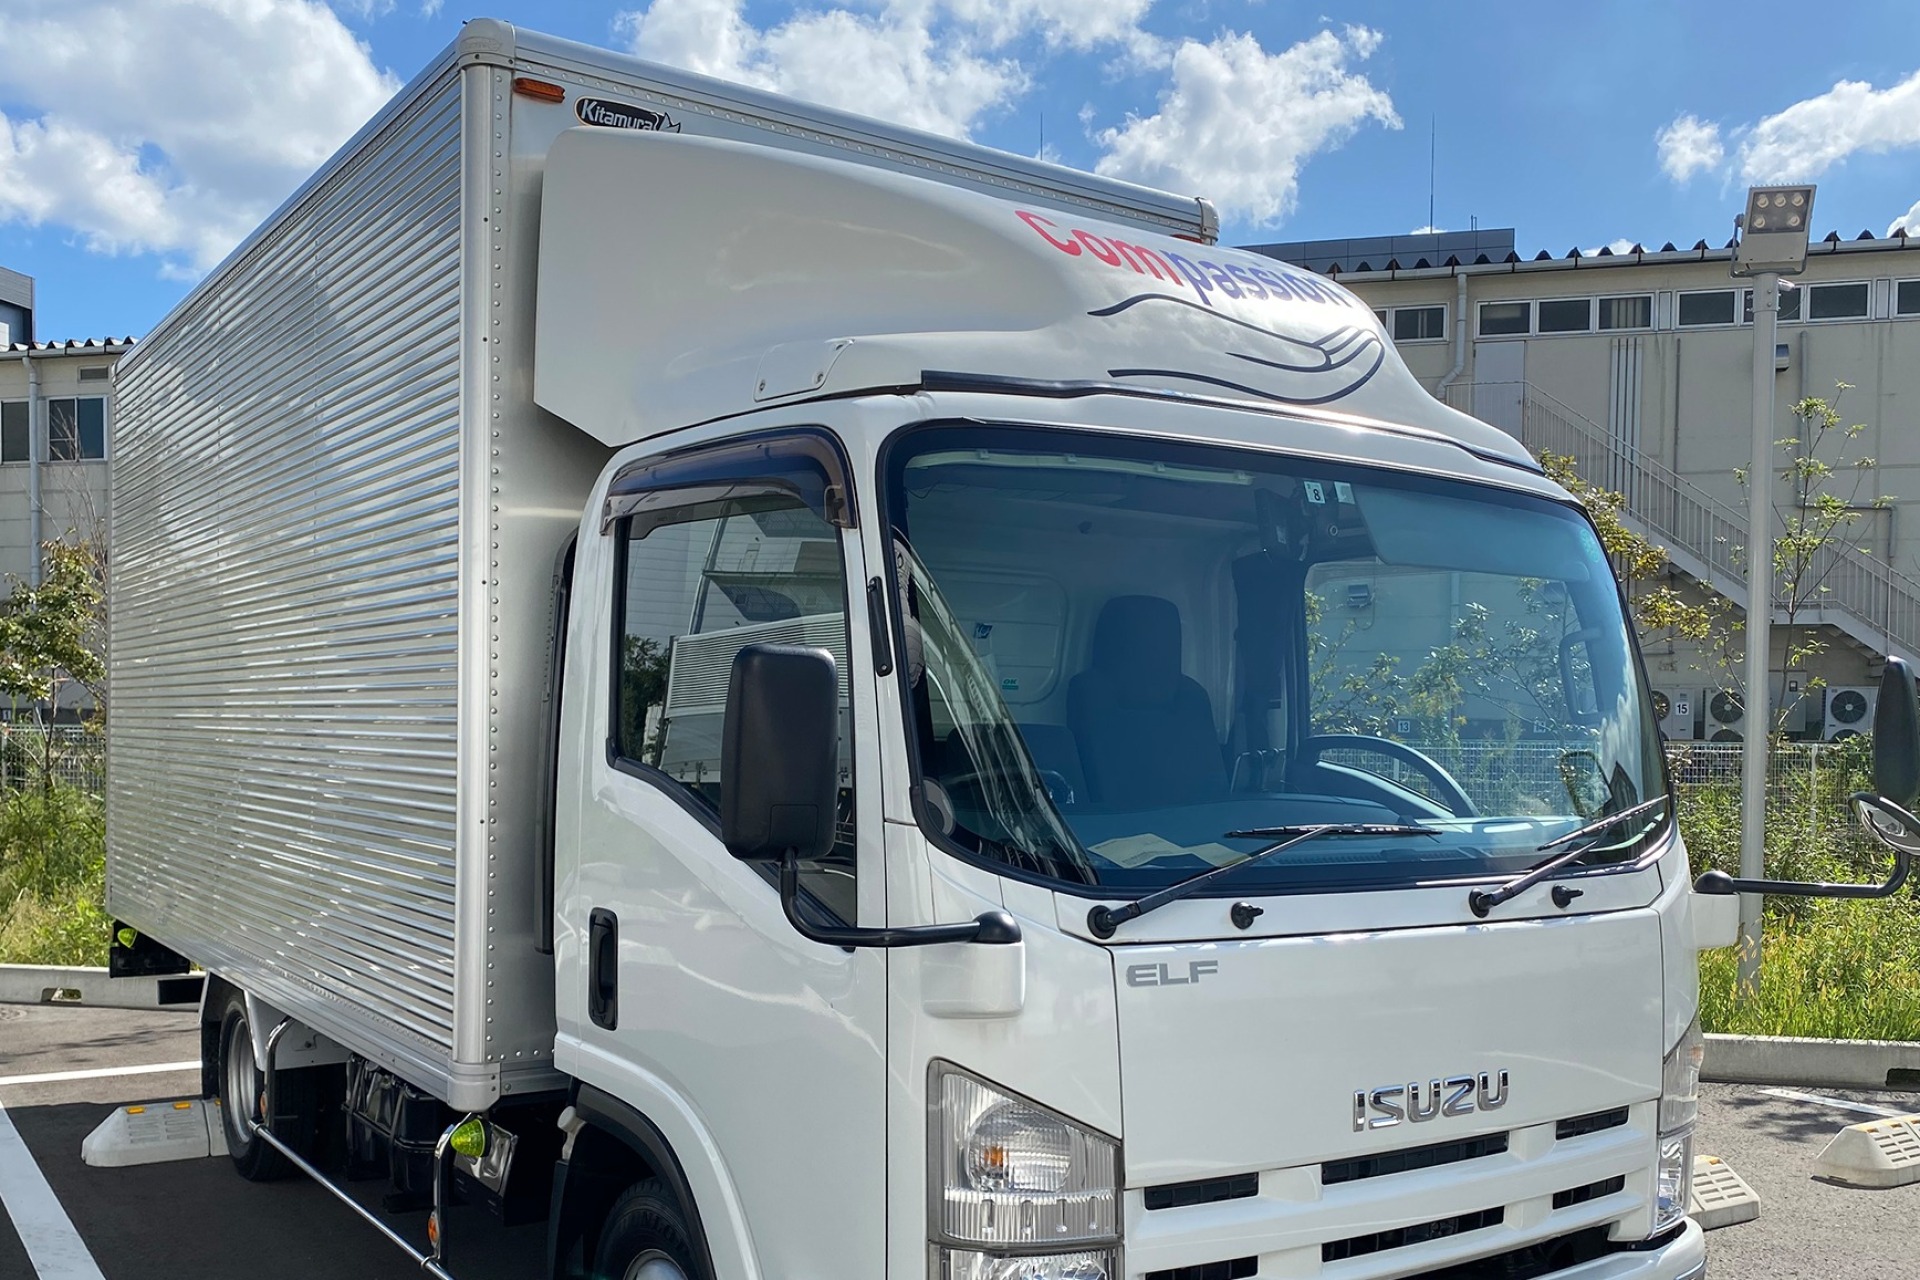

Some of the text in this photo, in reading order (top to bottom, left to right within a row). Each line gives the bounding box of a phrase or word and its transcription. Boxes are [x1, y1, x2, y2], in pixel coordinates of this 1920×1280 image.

[581, 99, 654, 131] Kitamura
[1015, 209, 1352, 307] Compassion
[1313, 488, 1321, 501] 8
[1676, 703, 1688, 714] 15
[1399, 721, 1409, 731] 13
[1126, 960, 1218, 987] ELF
[1353, 1068, 1509, 1132] ISUZU
